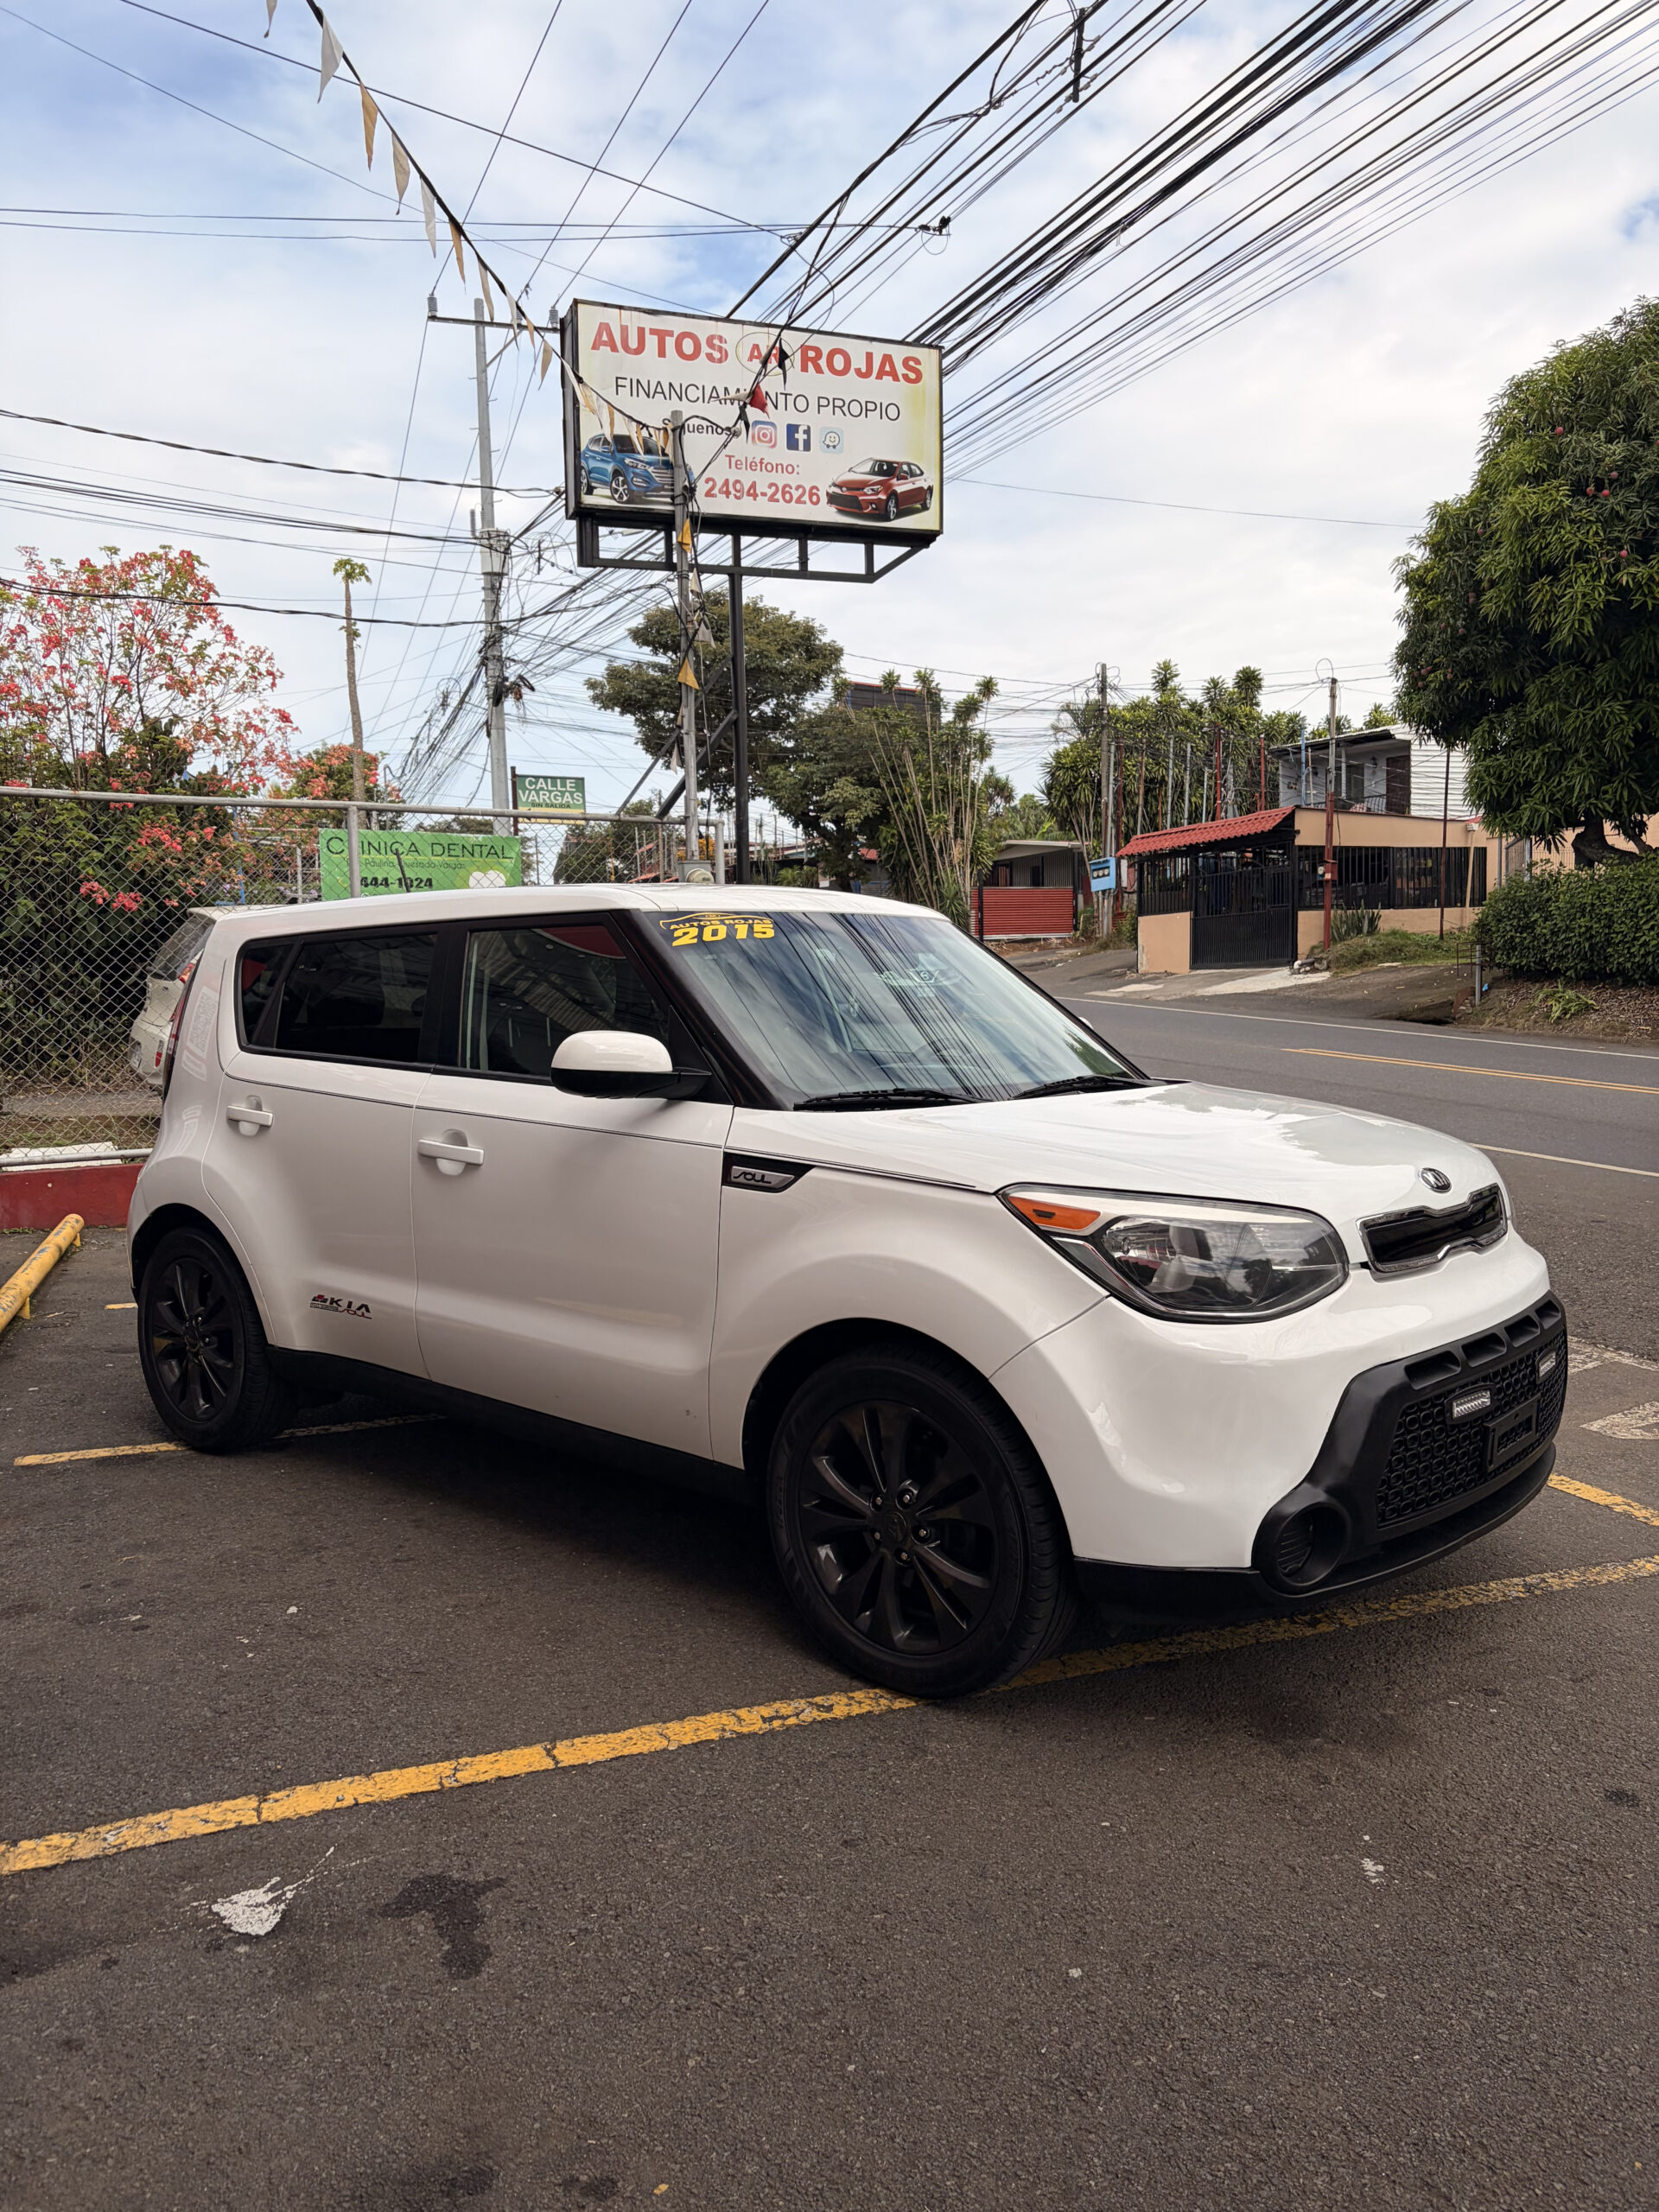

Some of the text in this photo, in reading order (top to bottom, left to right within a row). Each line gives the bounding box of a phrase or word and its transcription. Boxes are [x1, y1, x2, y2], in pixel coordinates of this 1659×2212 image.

[591, 321, 728, 364] AUTOS
[800, 344, 923, 385] ROJAS
[614, 377, 900, 421] FINANCIAMNTO PROPIO
[724, 454, 800, 476] Teléfono:
[704, 477, 821, 506] 2494-2626
[525, 778, 575, 791] CALLE
[518, 790, 583, 804] VARGAS
[327, 836, 514, 859] CINICA DENTAL
[670, 920, 720, 930] AUTOS
[672, 924, 774, 946] 2015
[329, 1297, 371, 1313] KIA
